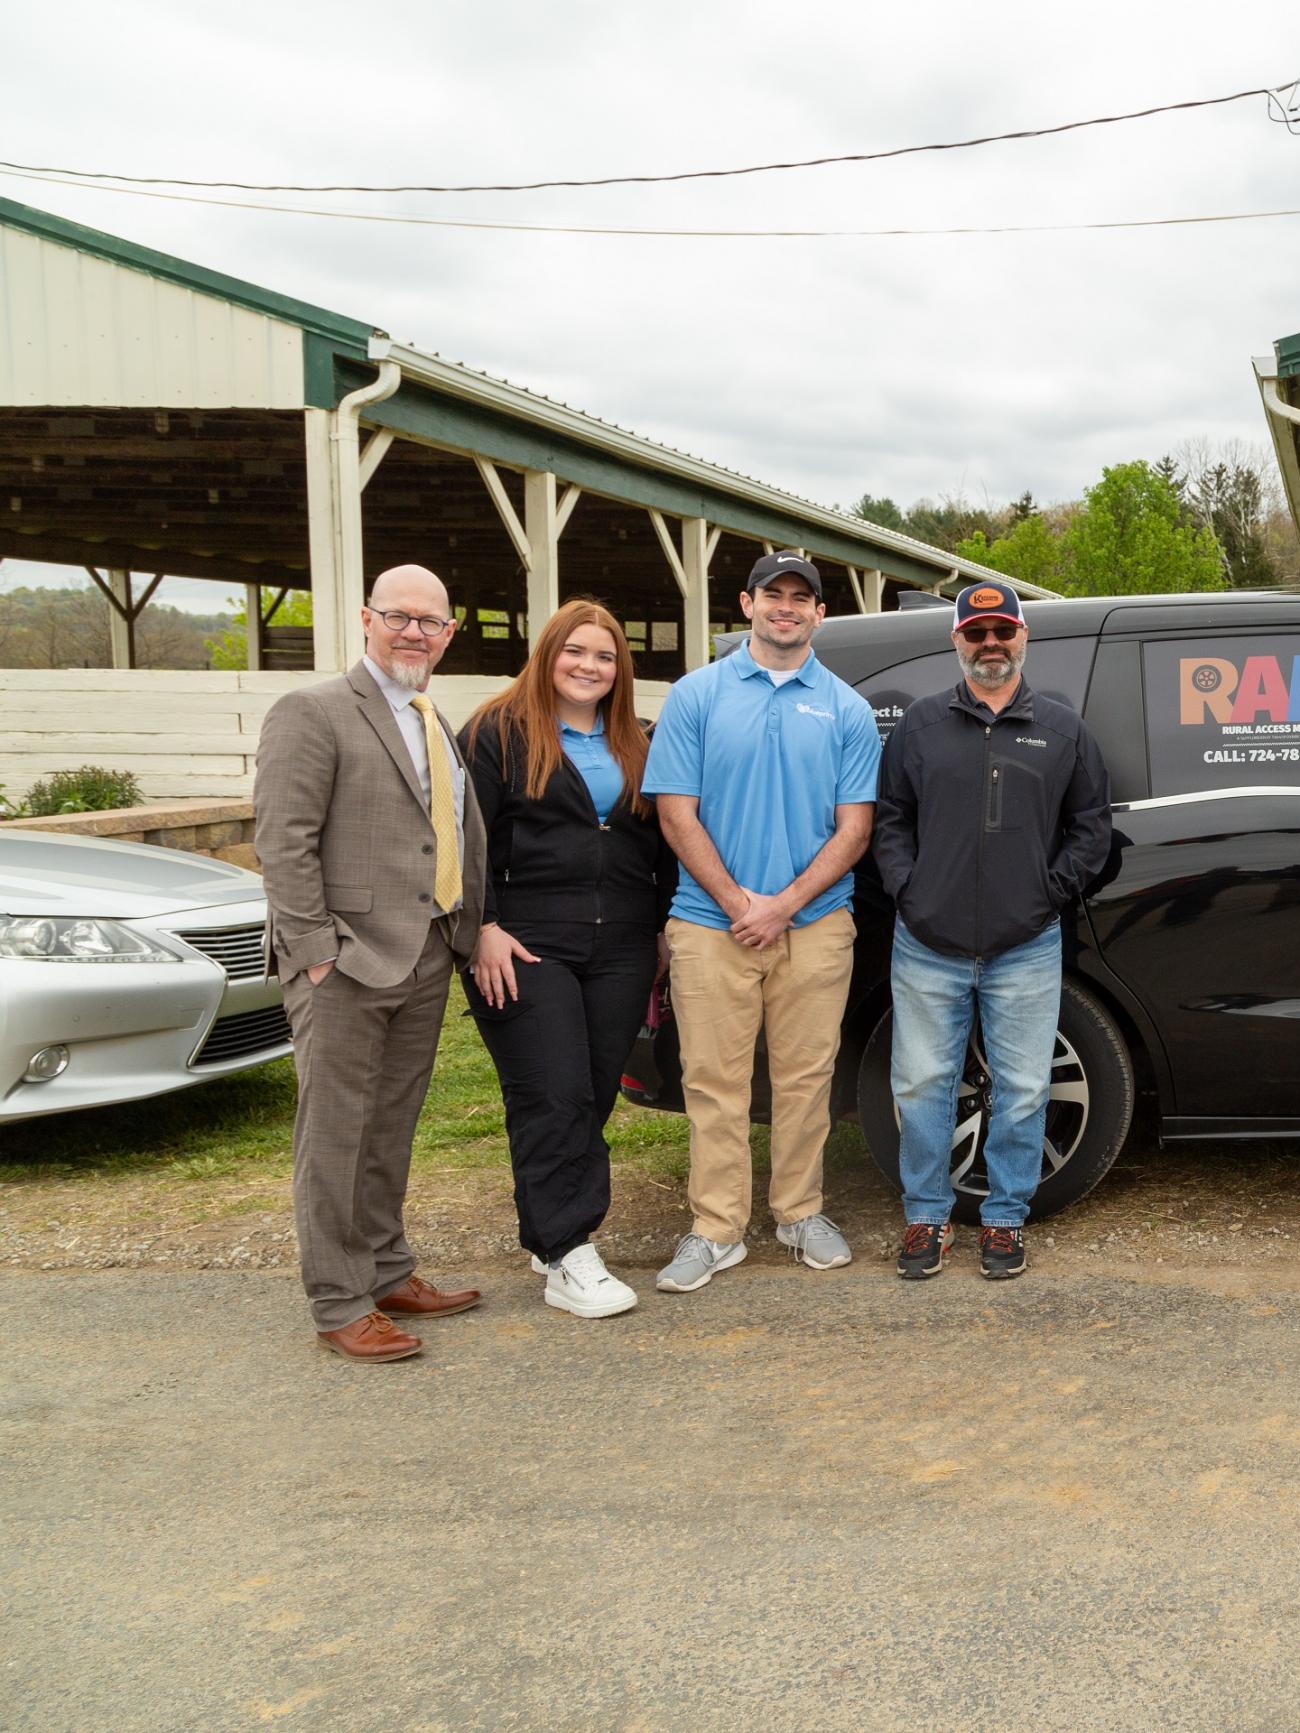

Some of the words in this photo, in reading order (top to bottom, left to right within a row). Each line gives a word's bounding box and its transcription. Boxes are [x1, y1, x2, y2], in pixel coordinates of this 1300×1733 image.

[1222, 725, 1254, 735] RURAL
[1255, 724, 1292, 734] ACCESS
[1203, 749, 1246, 763] CALL:
